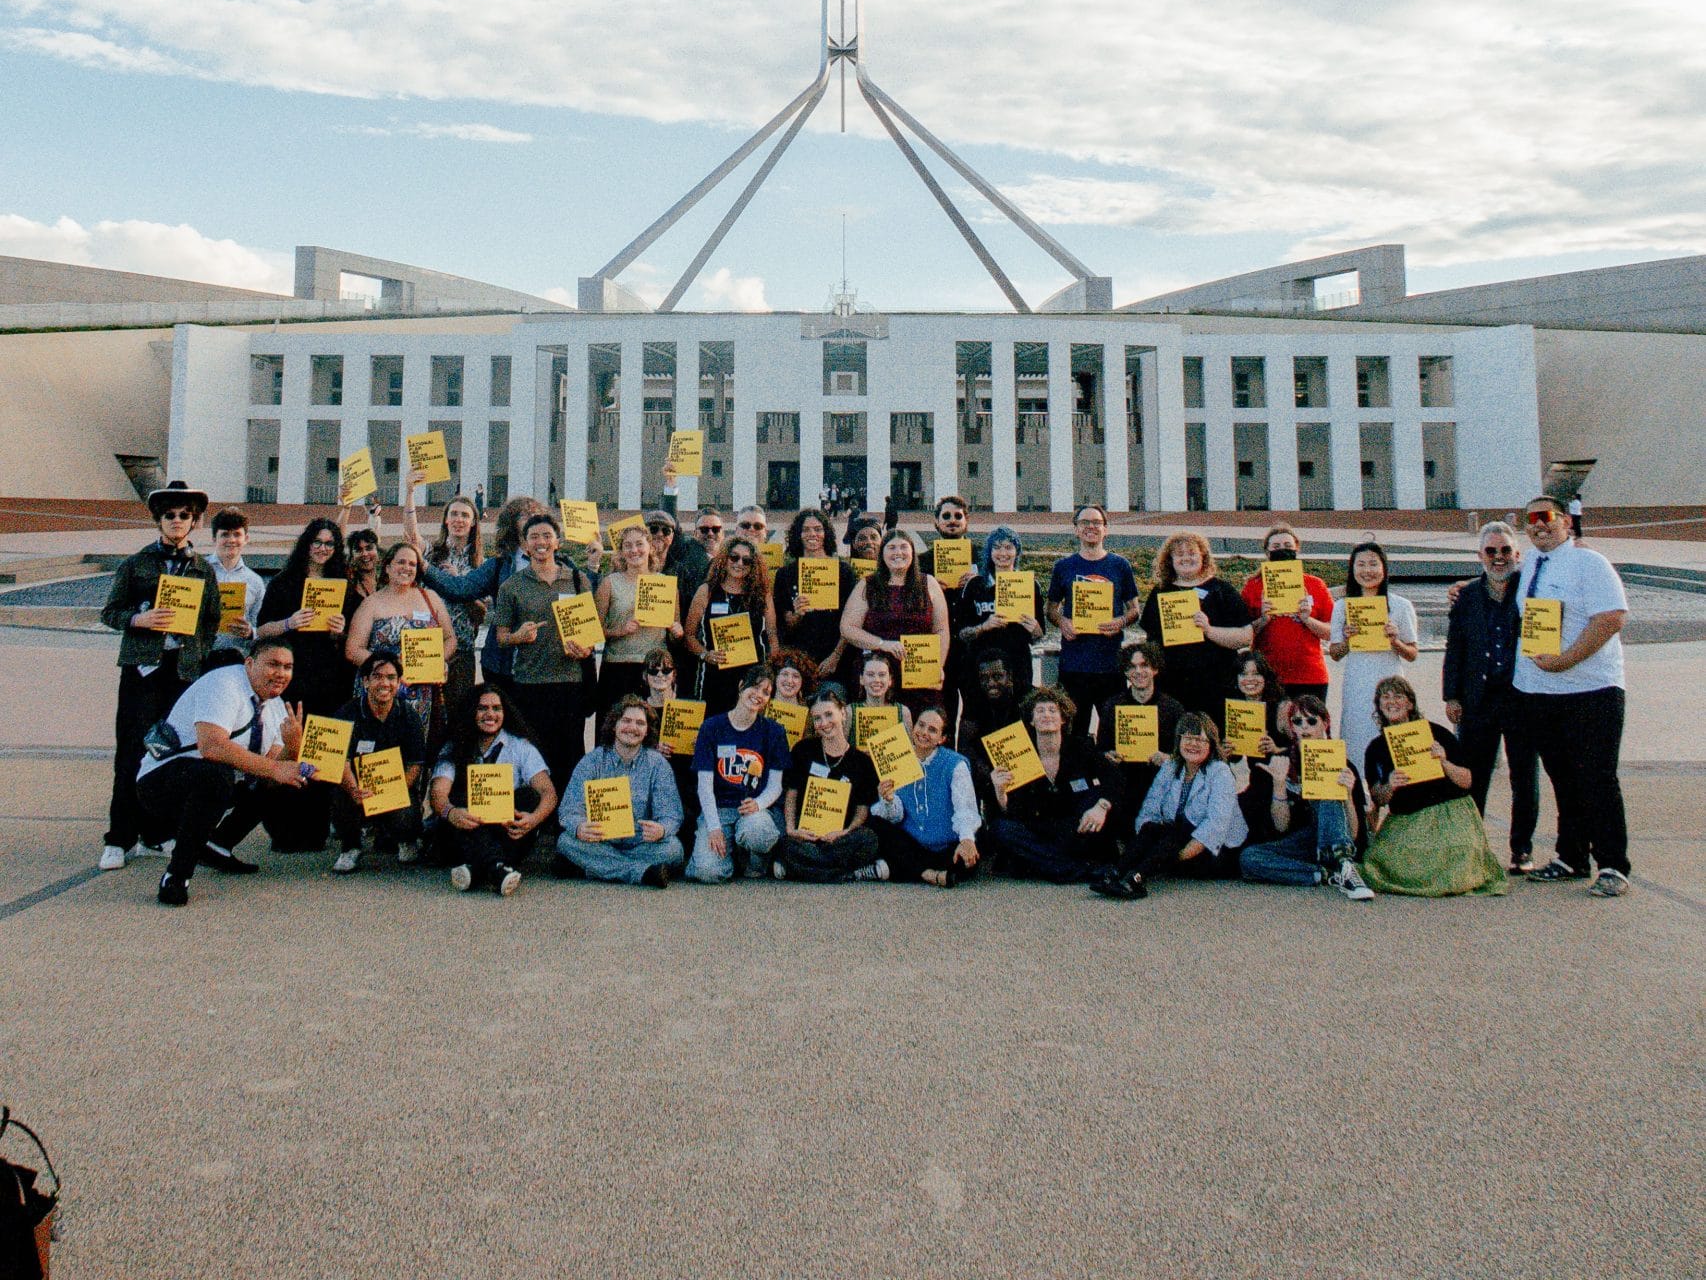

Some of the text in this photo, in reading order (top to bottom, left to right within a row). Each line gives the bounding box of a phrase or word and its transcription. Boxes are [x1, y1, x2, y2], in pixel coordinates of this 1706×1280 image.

[162, 583, 191, 591] NATIONAL
[159, 600, 197, 610] AUSTRALIANS
[557, 602, 584, 613] NATIONAL
[562, 616, 596, 630] AUSTRALIANS
[308, 724, 339, 734] NATIONAL
[871, 736, 897, 750] NATIONAL
[304, 743, 344, 755] AUSTRALIANS
[877, 749, 911, 768] AUSTRALIANS
[809, 785, 838, 794] NATIONAL
[590, 804, 629, 813] AUSTRALIANS
[806, 802, 842, 813] AUSTRALIANS
